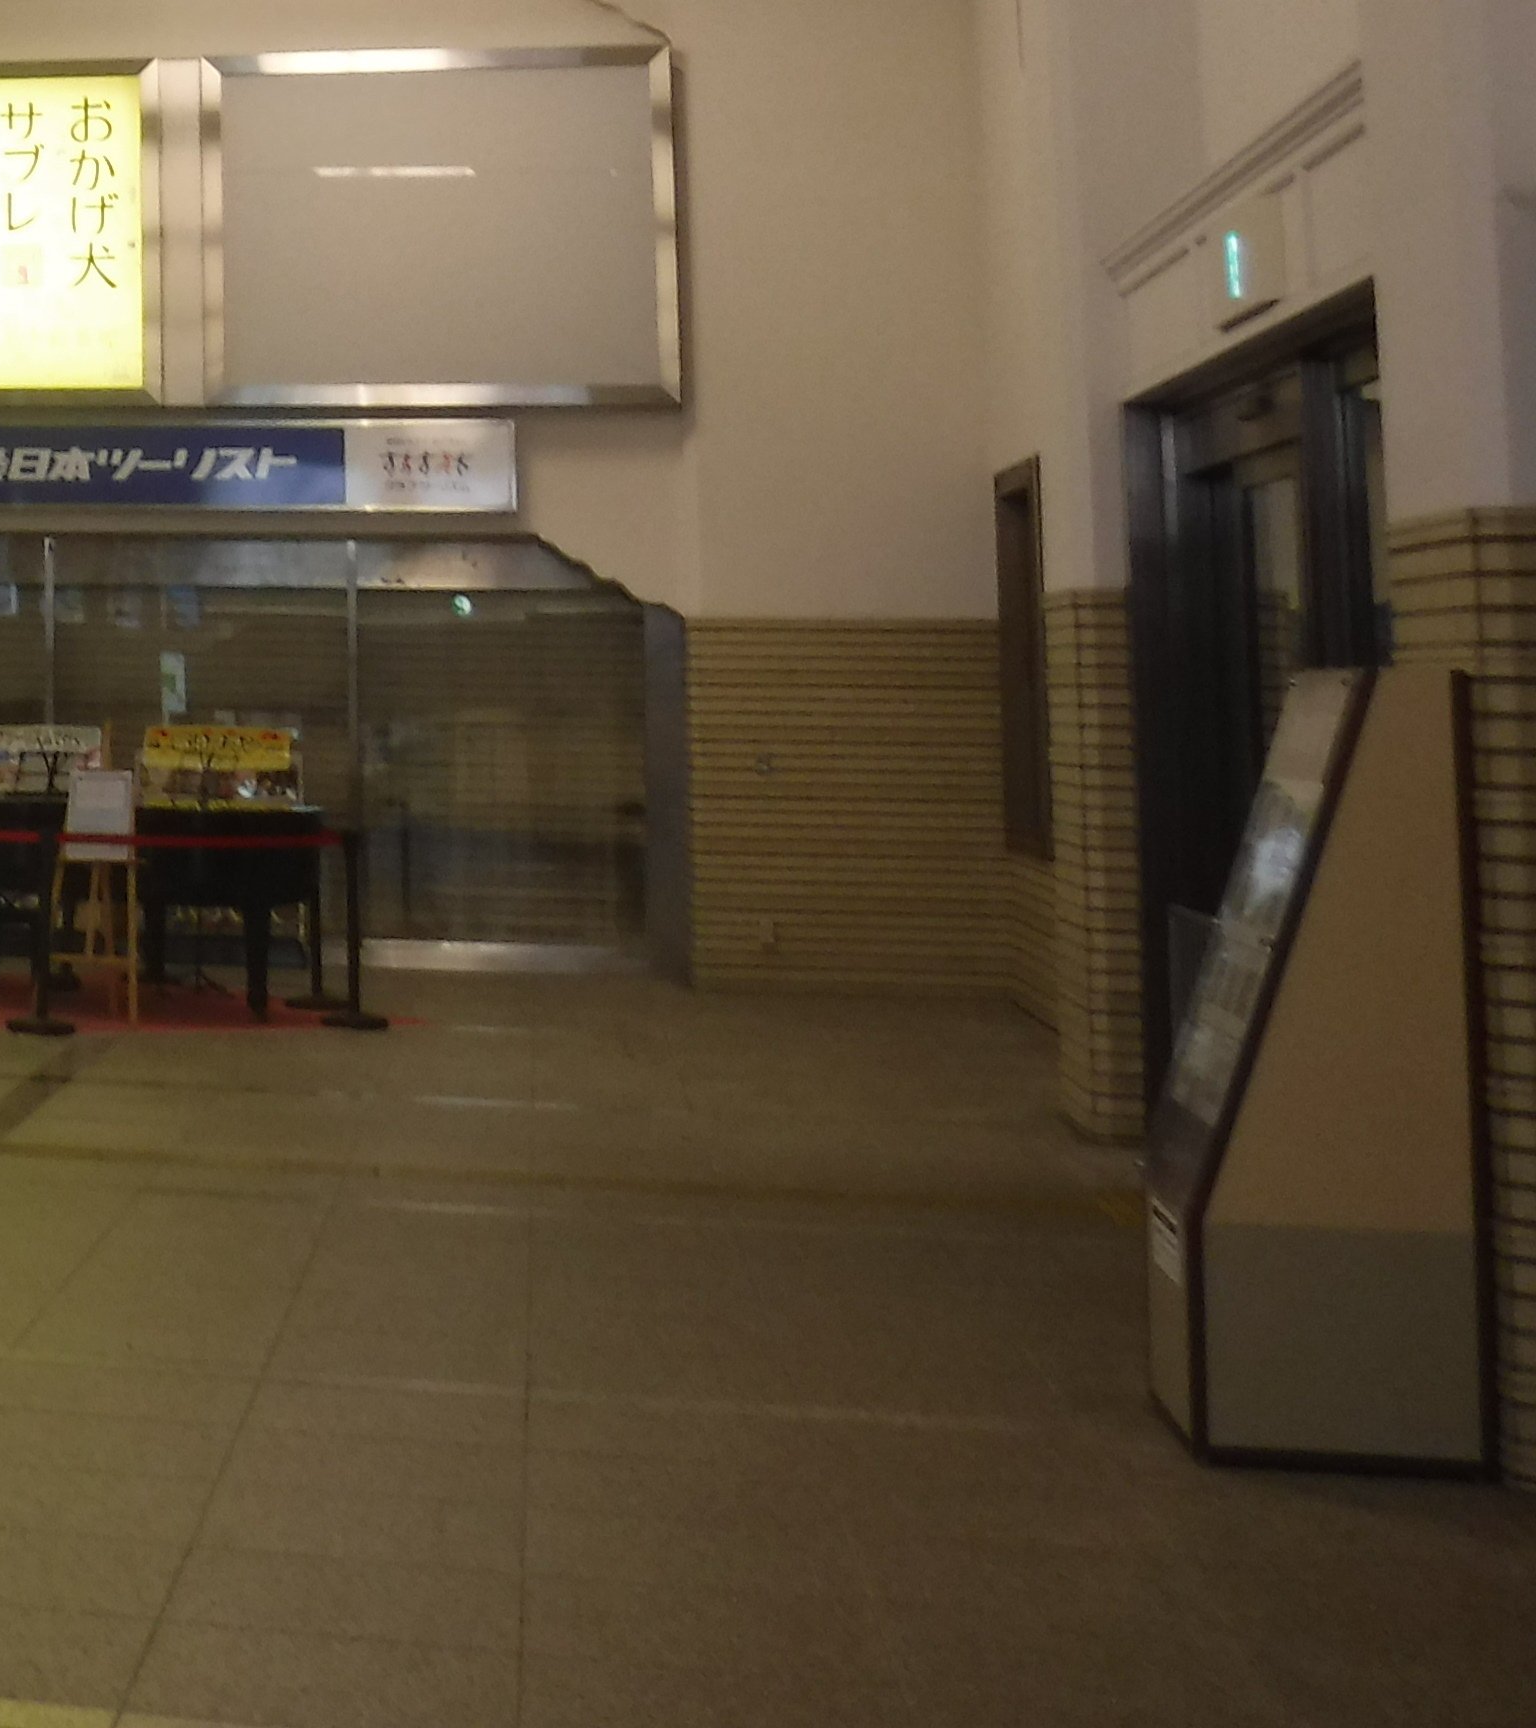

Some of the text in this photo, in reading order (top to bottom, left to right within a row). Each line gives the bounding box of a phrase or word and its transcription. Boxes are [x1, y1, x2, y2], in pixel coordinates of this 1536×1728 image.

[1, 102, 45, 231] サブレ
[70, 96, 118, 289] おかげ犬
